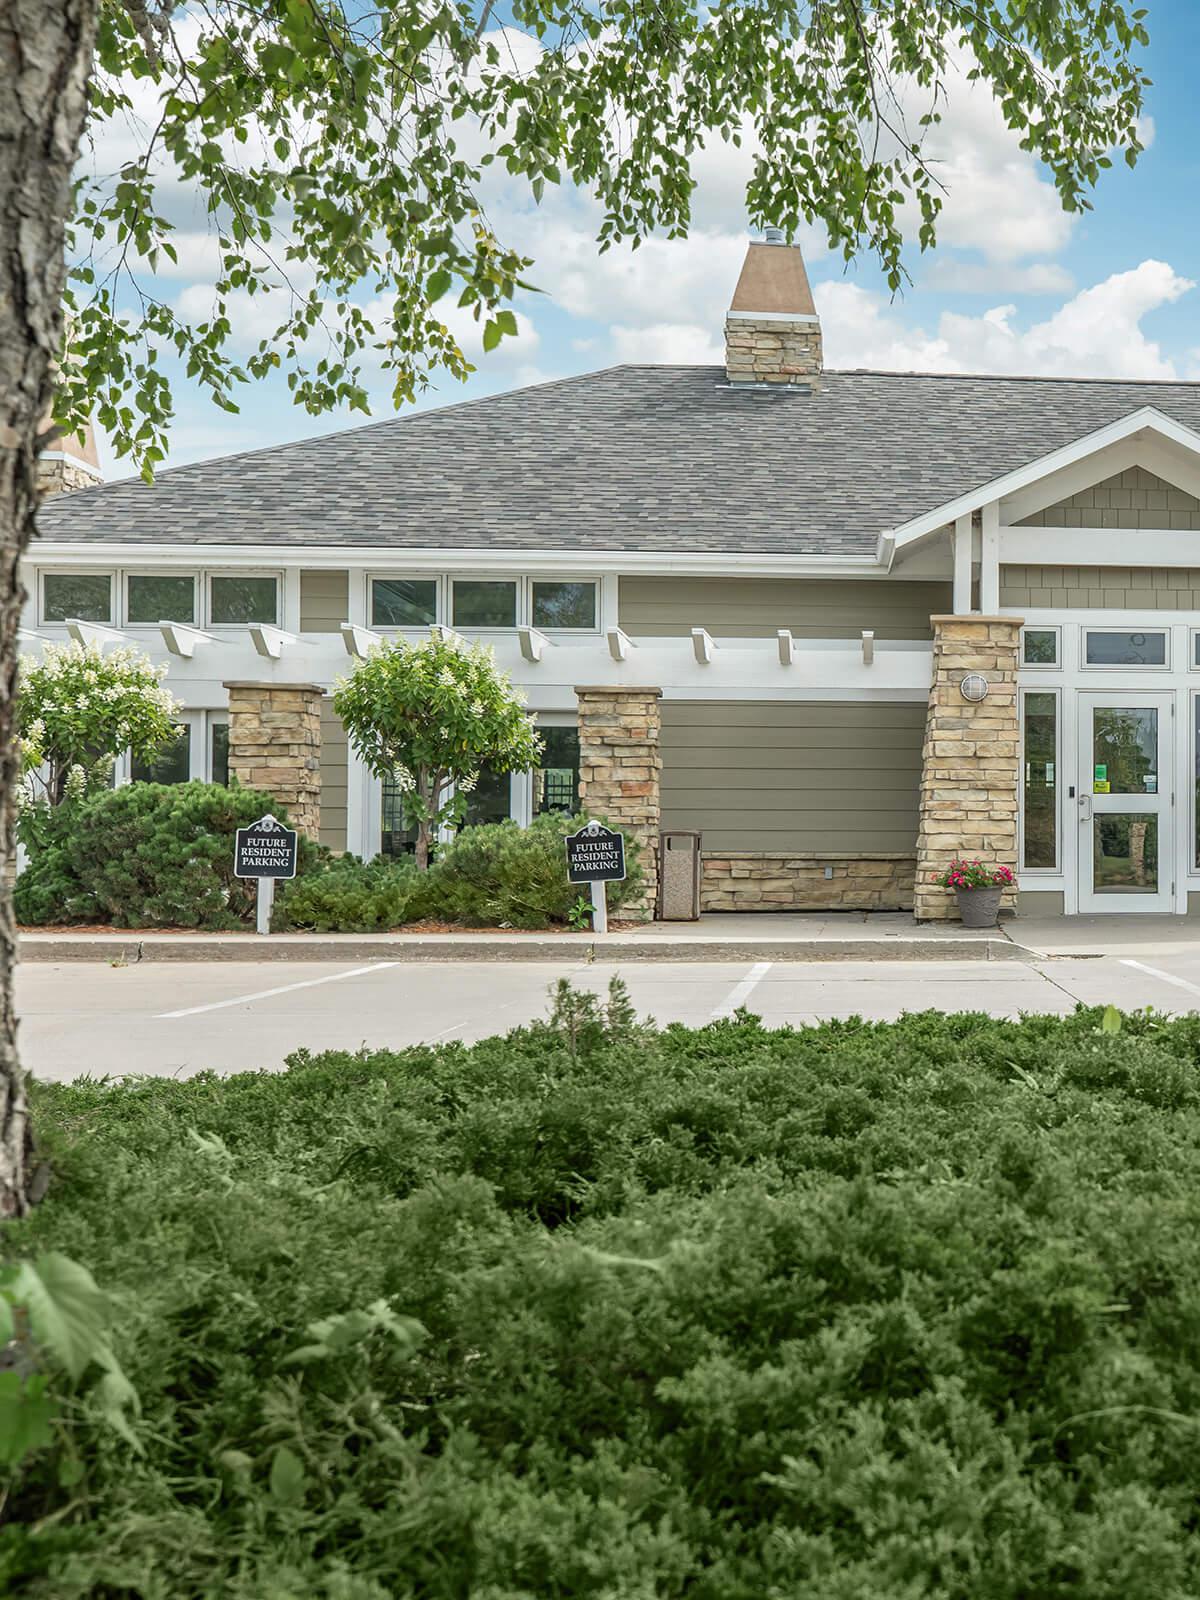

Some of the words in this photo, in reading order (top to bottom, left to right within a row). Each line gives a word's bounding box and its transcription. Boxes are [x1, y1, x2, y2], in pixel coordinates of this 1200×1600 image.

[247, 838, 287, 847] FUTURE
[576, 842, 614, 852] FUTURE
[241, 847, 292, 857] RESIDENT
[571, 851, 620, 862] RESIDENT
[242, 857, 289, 867] PARKING
[574, 860, 619, 871] PARKING
